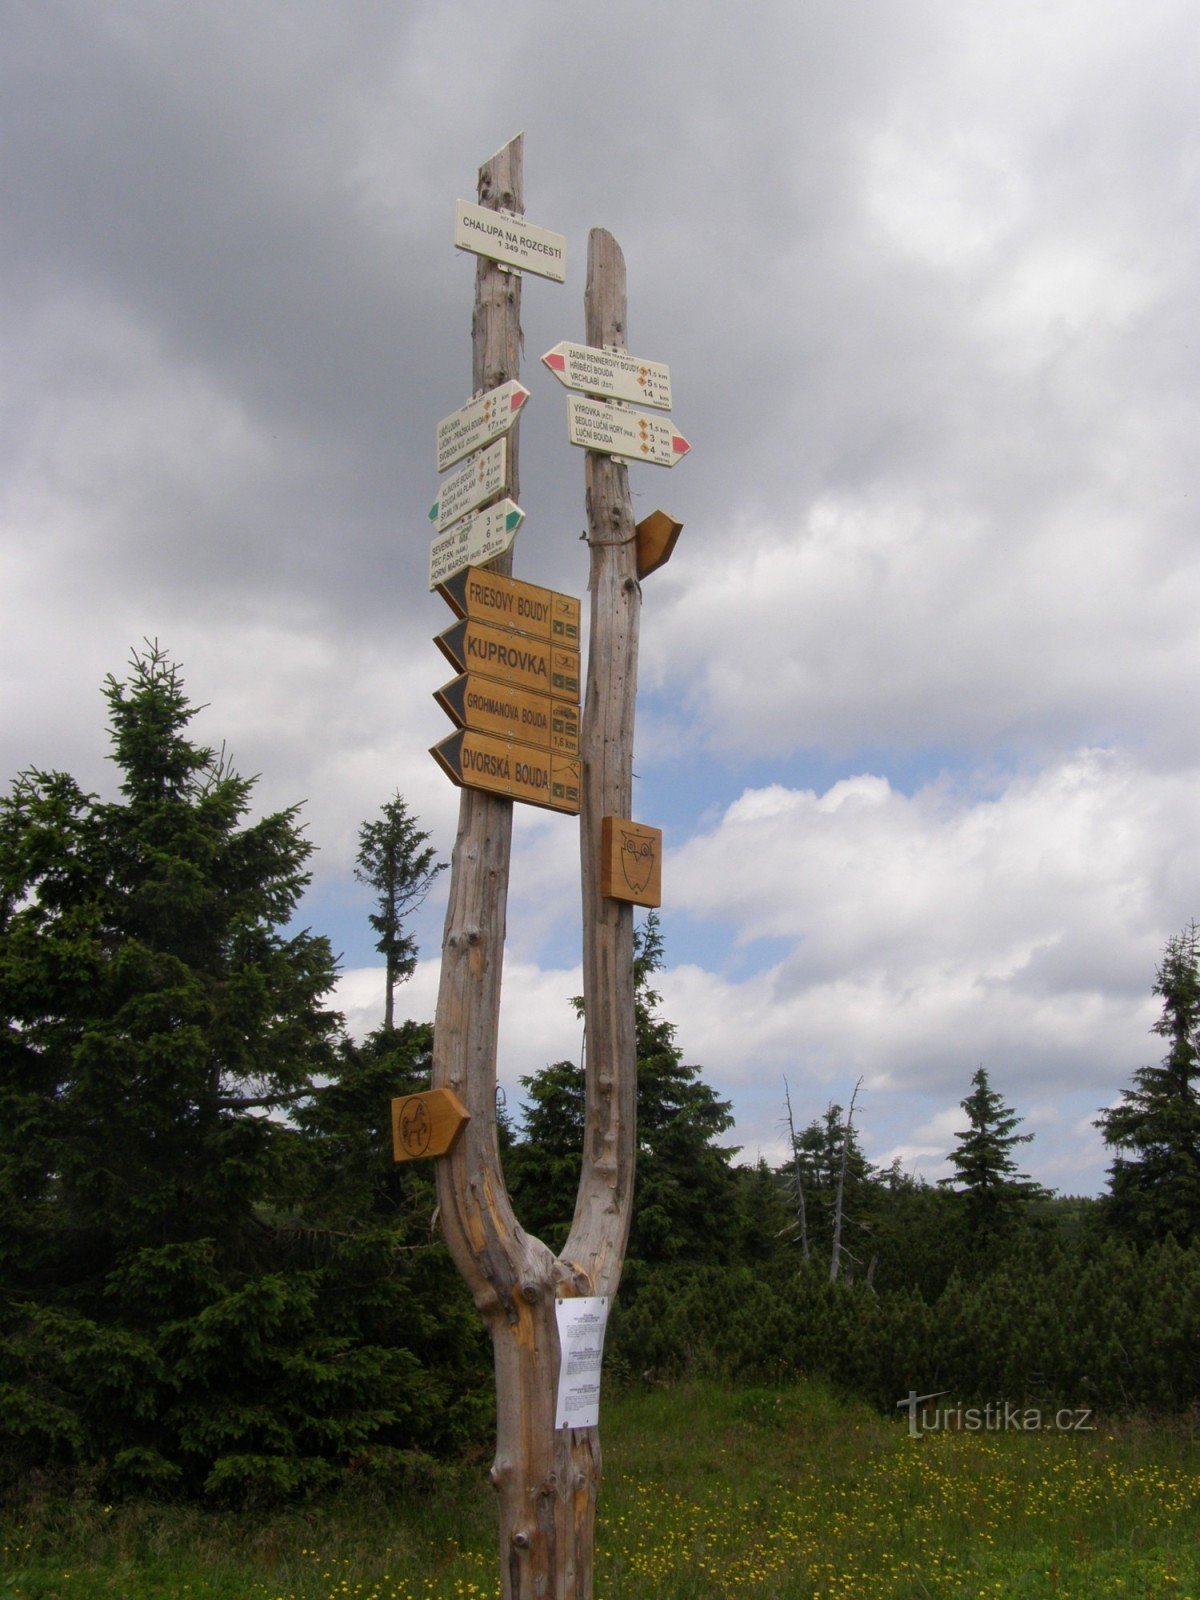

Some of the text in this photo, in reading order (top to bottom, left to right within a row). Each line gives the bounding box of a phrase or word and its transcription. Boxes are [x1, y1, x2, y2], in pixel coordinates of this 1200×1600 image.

[463, 216, 504, 239] CHALUPA
[506, 232, 518, 244] NA
[520, 236, 562, 259] ROZCESTÍ
[504, 242, 518, 252] 349
[568, 350, 586, 360] ZADNÍ
[586, 354, 620, 368] RENNEROVY
[621, 361, 640, 372] BOUDY
[658, 372, 668, 380] km
[594, 366, 614, 378] BOUDA
[570, 372, 600, 386] VRCHLABÍ
[643, 389, 654, 398] 14
[660, 394, 669, 402] km
[492, 397, 496, 406] 3
[492, 408, 496, 418] 6
[574, 404, 600, 417] VÝROVKA
[575, 416, 592, 427] SEDLO
[593, 420, 608, 431] LUČNÍ
[609, 425, 624, 434] HORY
[650, 434, 655, 442] 3
[576, 427, 592, 440] LUČNÍ
[594, 432, 613, 444] BOUDA
[650, 446, 656, 454] 4
[487, 456, 490, 464] 1
[442, 494, 456, 510] BOUDA
[432, 537, 455, 556] SEVERKA
[486, 516, 490, 526] 3
[432, 556, 441, 568] PEC
[486, 529, 490, 538] 6
[431, 566, 446, 580] HORNÍ
[448, 553, 469, 571] MARŠOV
[496, 538, 503, 546] km
[470, 582, 548, 623] FRIESOVY BOUDY
[468, 635, 548, 678] KUPROVKA
[467, 692, 548, 729] GROHMANOVA BOUDA
[565, 740, 576, 751] km
[463, 748, 548, 790] DVORSKÁ BOUDA
